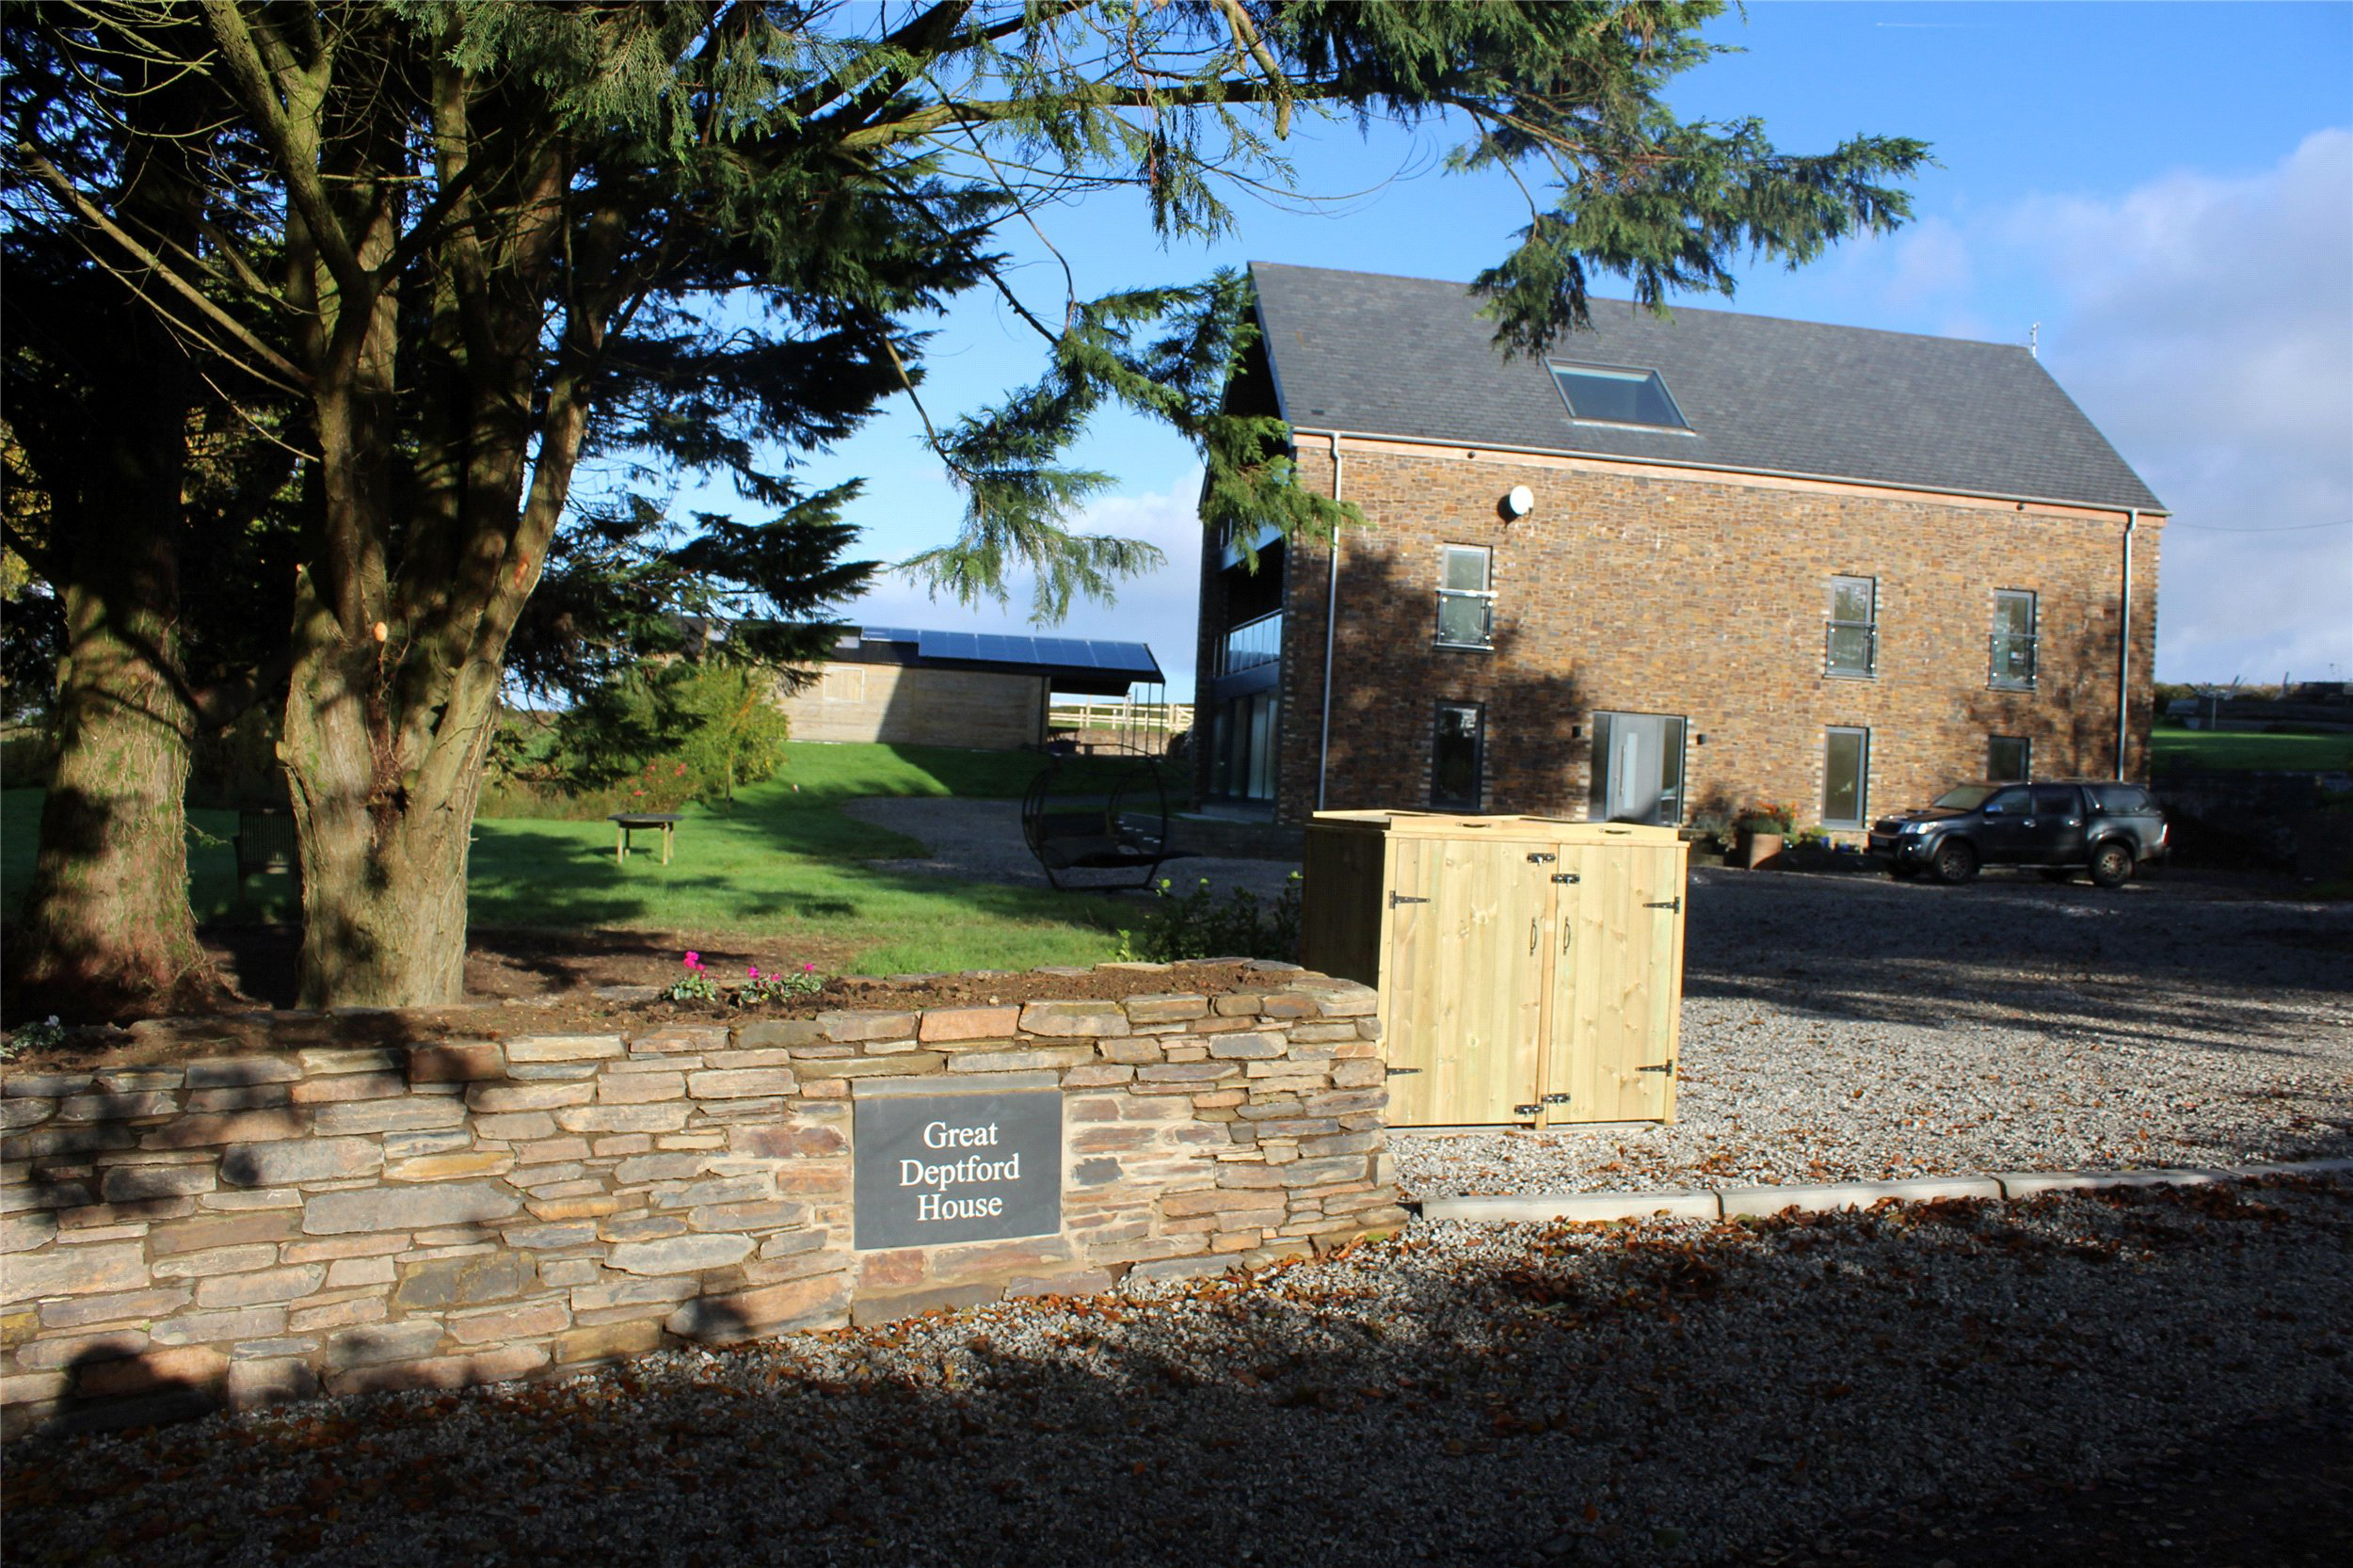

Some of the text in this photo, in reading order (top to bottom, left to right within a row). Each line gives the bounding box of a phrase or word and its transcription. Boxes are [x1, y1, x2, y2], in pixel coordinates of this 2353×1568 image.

[923, 1121, 998, 1148] Great
[900, 1153, 1020, 1191] Deptford
[917, 1193, 1002, 1221] House
